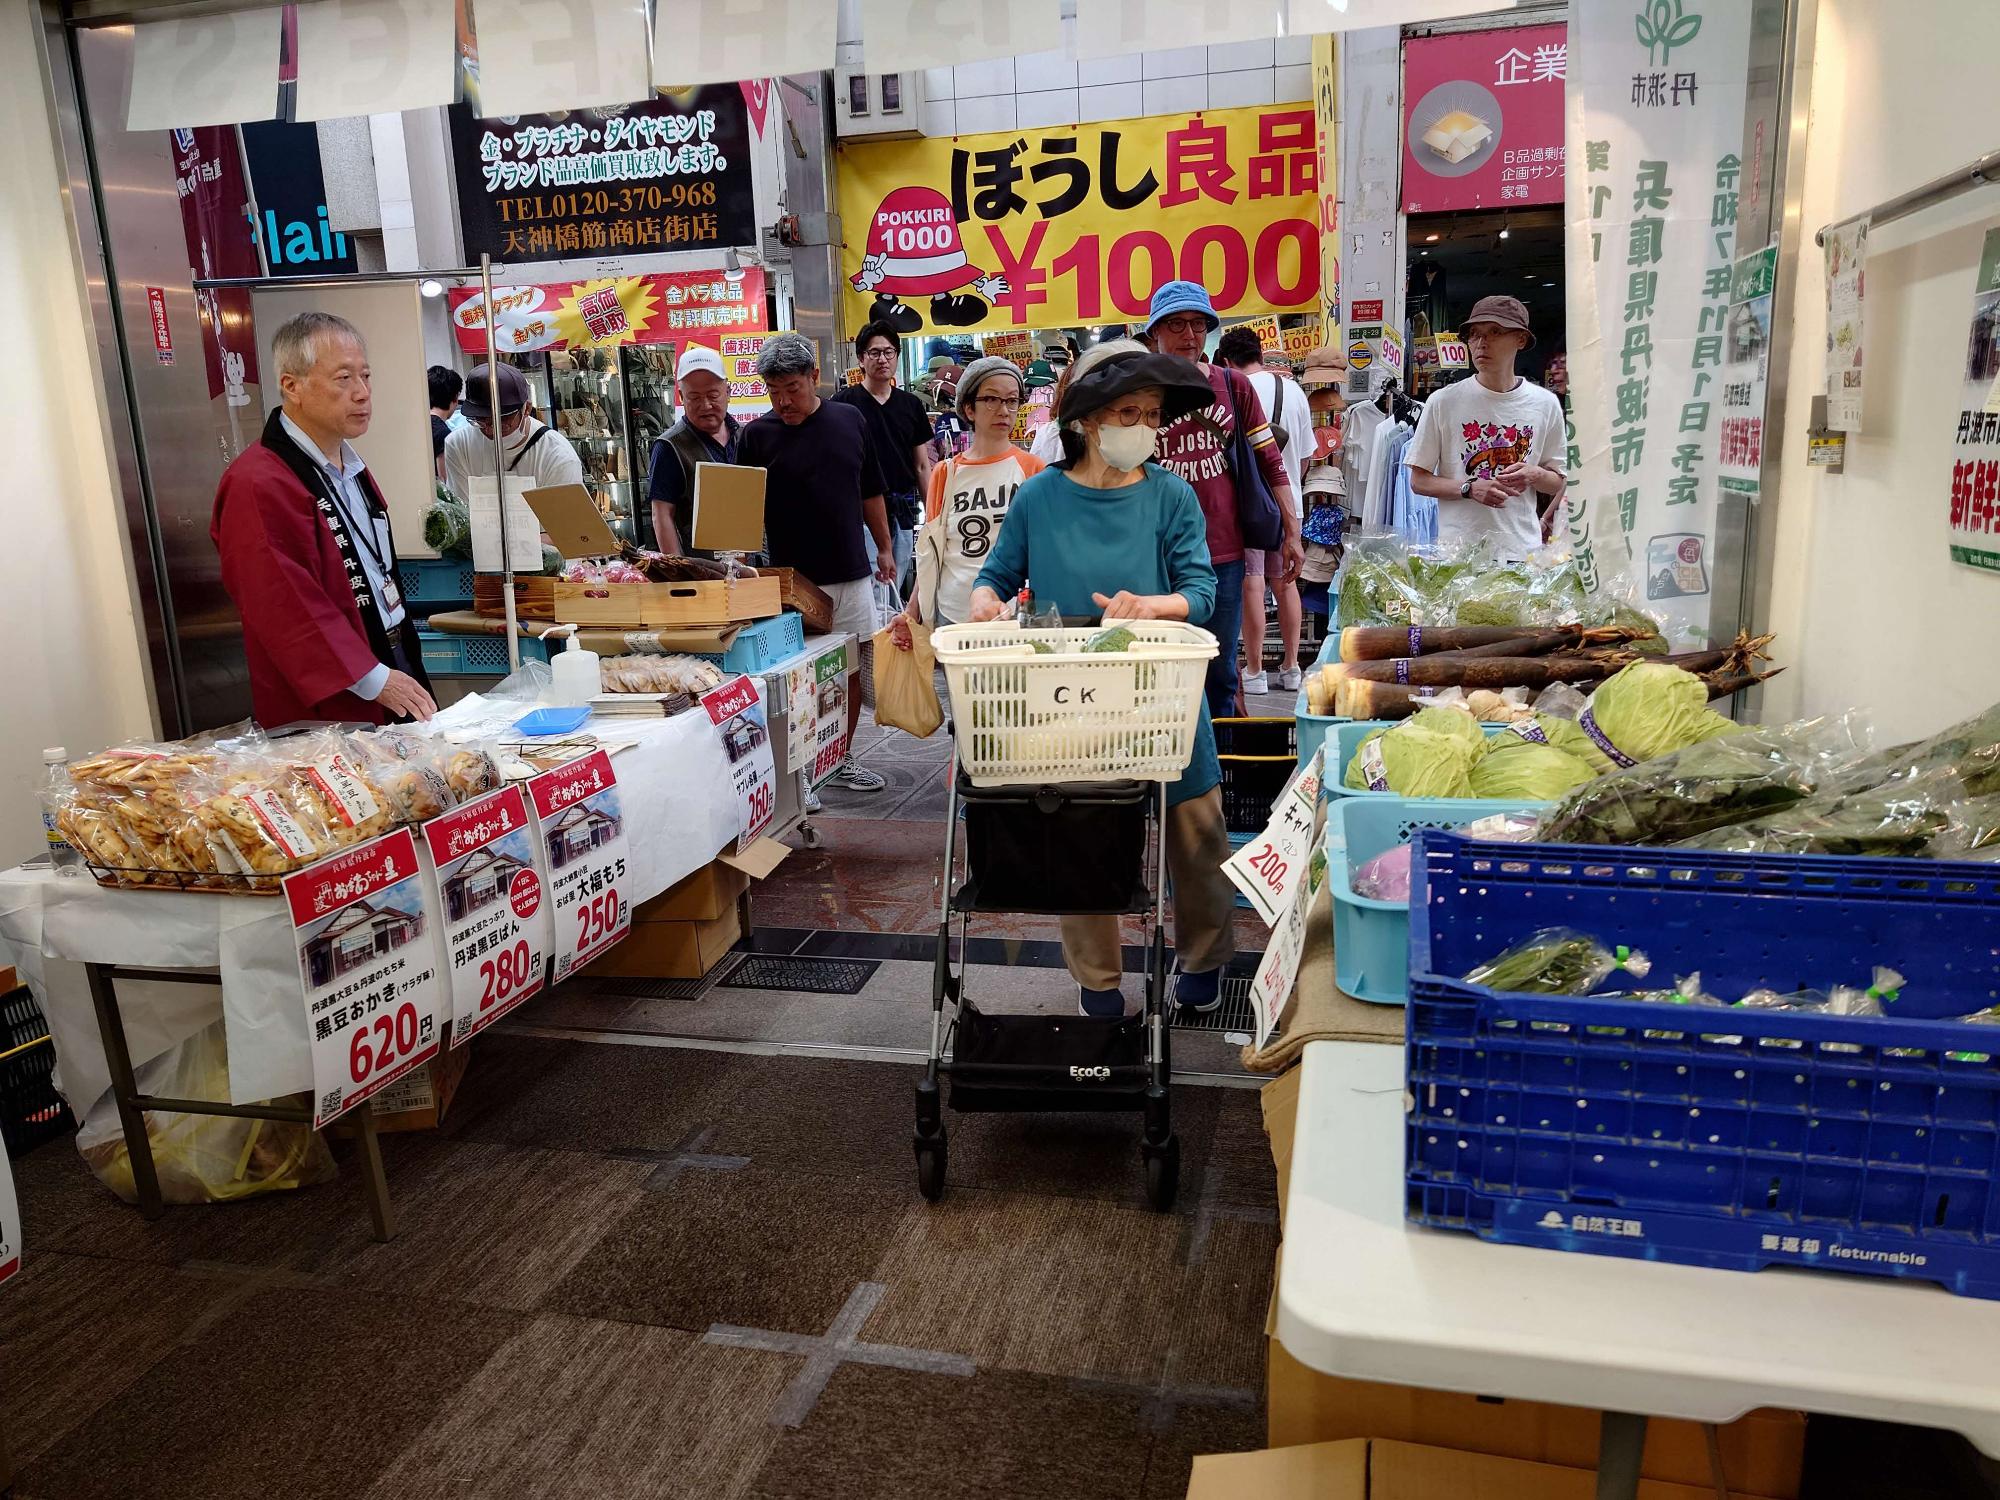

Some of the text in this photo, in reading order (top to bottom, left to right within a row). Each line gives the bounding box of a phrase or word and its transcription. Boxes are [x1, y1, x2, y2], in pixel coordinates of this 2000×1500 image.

[1494, 43, 1567, 86] 企業
[480, 110, 716, 161] 金・プラチナ・ダイヤモンド
[483, 144, 727, 192] ブランド品高価買取致します。
[951, 109, 1316, 223] ぼうし良品
[496, 181, 717, 221] TEL0120-370-968
[1501, 185, 1529, 199] 家電
[501, 212, 718, 255] 天神橋筋商店街店
[877, 207, 951, 225] POKKIRI
[880, 224, 953, 252] 1000
[460, 287, 535, 326] 歯科クラップ
[579, 286, 618, 318] 高価
[665, 281, 744, 305] 金パラ製品
[512, 320, 546, 344] 金パラ
[586, 311, 631, 341] 買取
[996, 333, 1028, 347] 自転車
[1956, 410, 2000, 445] 丹波市
[1950, 459, 2000, 534] 新鮮
[958, 513, 1006, 558] 8
[814, 732, 847, 780] 新鮮野菜
[577, 857, 626, 902] 大福もち
[452, 909, 506, 946] 丹波黒大豆たっぷり
[455, 920, 520, 969] 丹波黒豆ぱん
[315, 982, 397, 1042] 黒豆おかき
[1572, 1214, 1643, 1237] 自然王国
[1761, 1234, 1928, 1267] 要返却 Returnable
